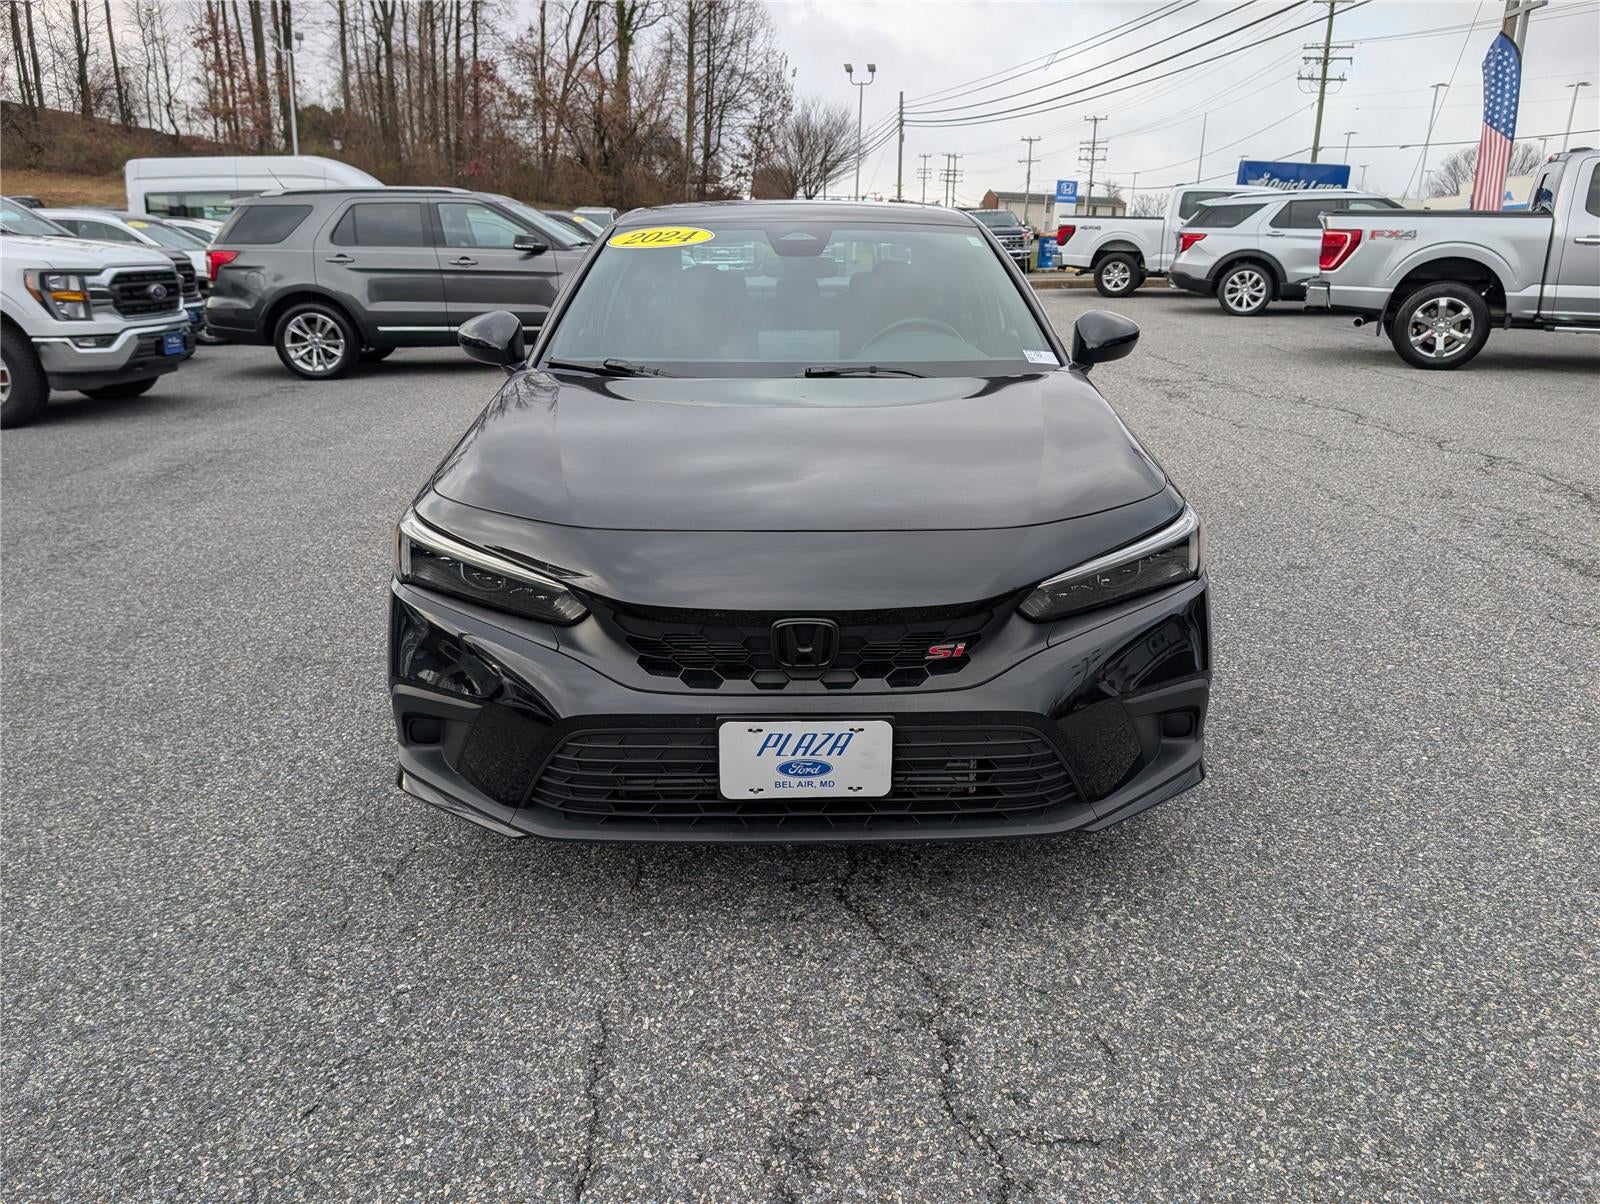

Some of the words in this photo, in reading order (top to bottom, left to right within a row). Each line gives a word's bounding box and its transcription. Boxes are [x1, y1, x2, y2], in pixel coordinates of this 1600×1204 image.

[1268, 178, 1307, 190] Quick
[621, 230, 699, 245] 2024
[1369, 229, 1417, 240] FX4
[756, 733, 854, 757] PLAZA
[788, 762, 822, 774] Ford
[774, 780, 794, 789] BEL
[796, 780, 817, 789] AIR,
[819, 780, 836, 788] MD
